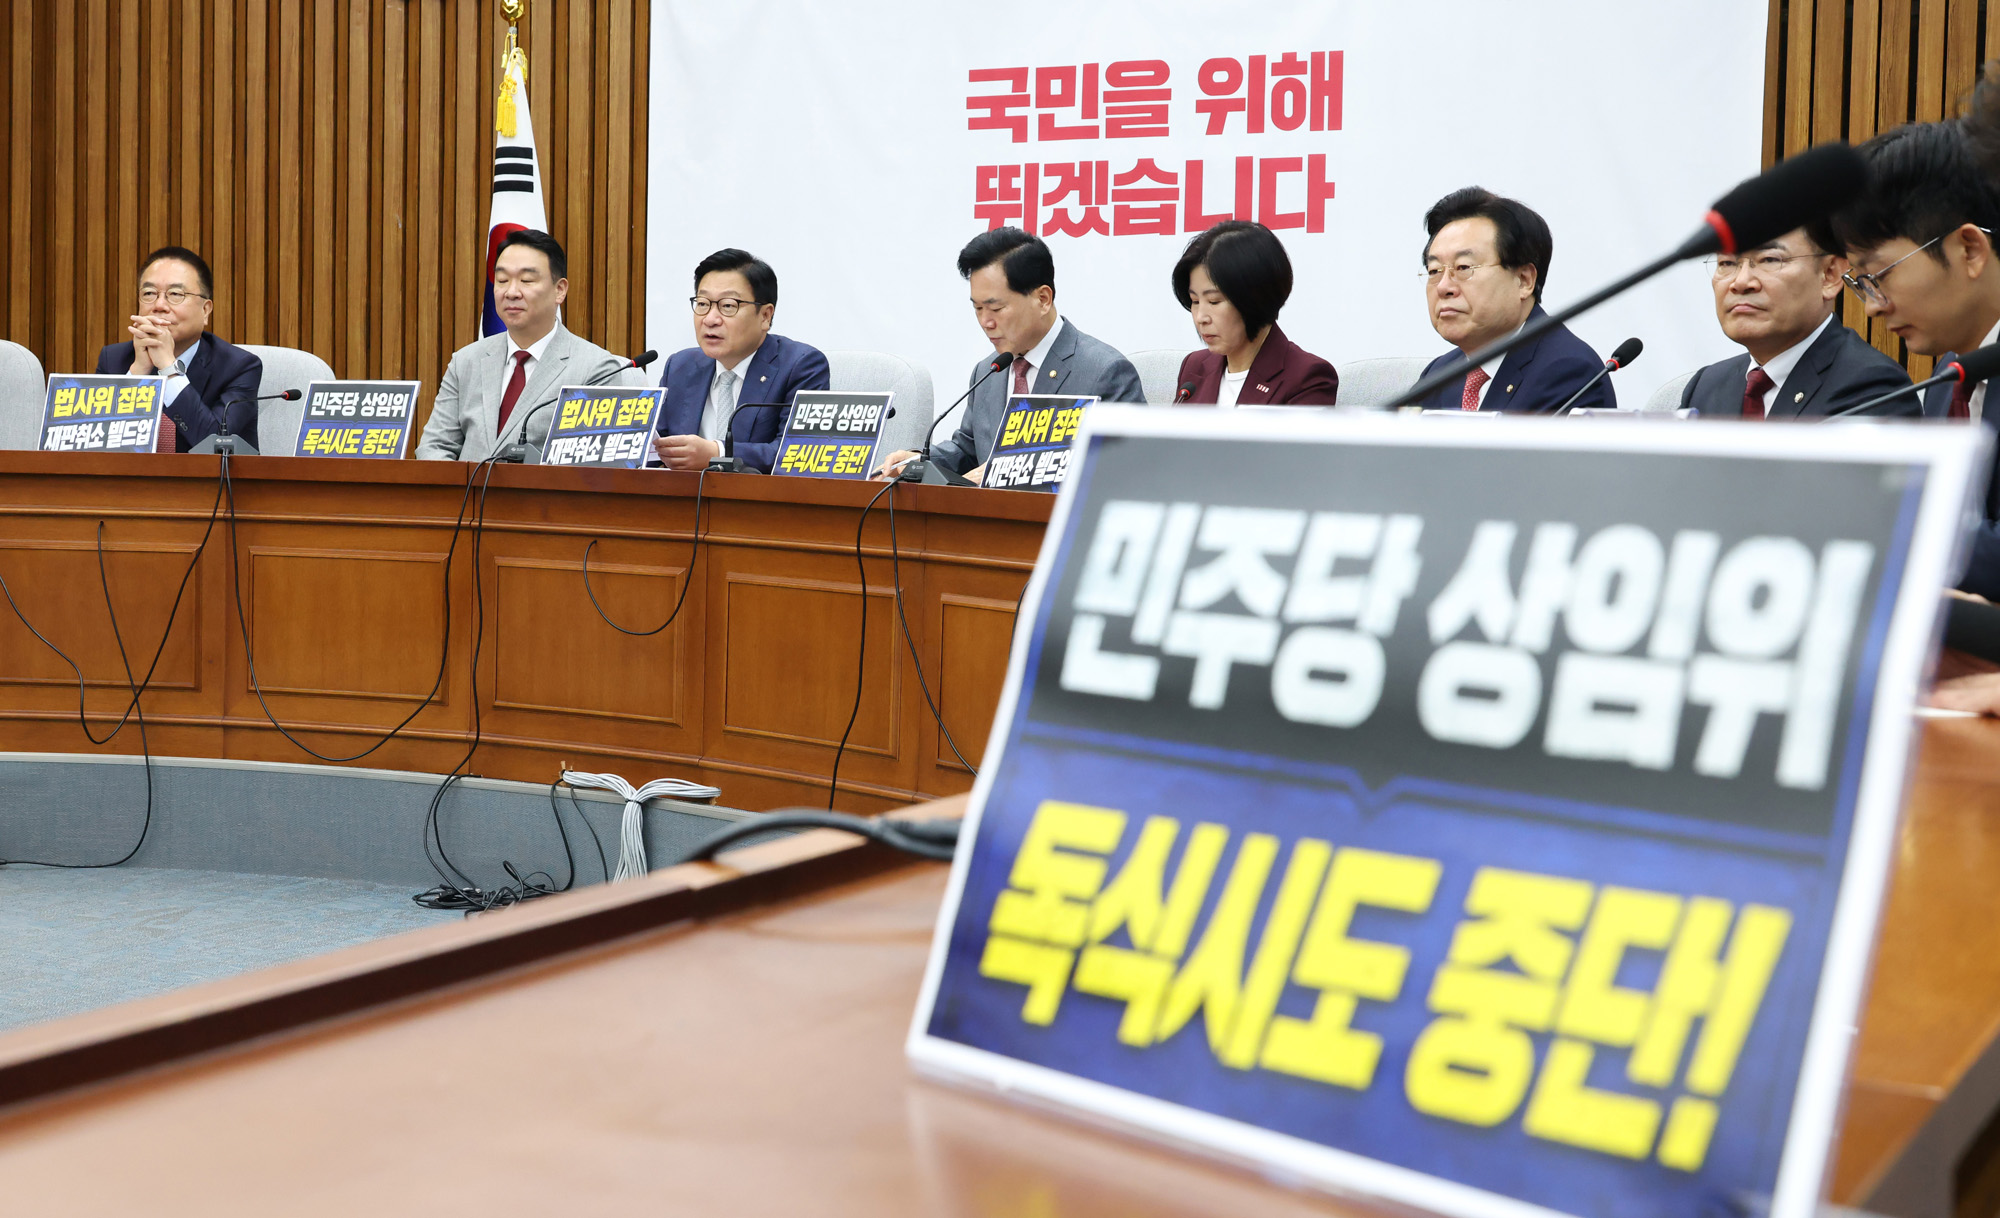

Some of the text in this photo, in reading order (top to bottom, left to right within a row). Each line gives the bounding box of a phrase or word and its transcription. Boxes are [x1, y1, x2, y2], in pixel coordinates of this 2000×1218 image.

[966, 50, 1344, 143] 국민을 위해
[974, 153, 1336, 238] 뛰겠습니다
[53, 385, 156, 417] 법사위 집착
[310, 391, 409, 417] 민주당 상임위
[558, 397, 654, 430] 법사위 집착
[792, 403, 883, 432] 민주당 상임위
[43, 419, 154, 451] 재판취소 빌드업
[302, 428, 401, 455] 독식시도 중단!
[1001, 407, 1086, 447] 법사위 집착
[547, 432, 648, 465] 재판취소 빌드업
[780, 444, 871, 474] 독식시도 중단!
[985, 451, 1035, 488] 재판취소
[1059, 500, 1875, 793] 민주당 상임위
[978, 799, 1793, 1173] 독식시도 중단!
